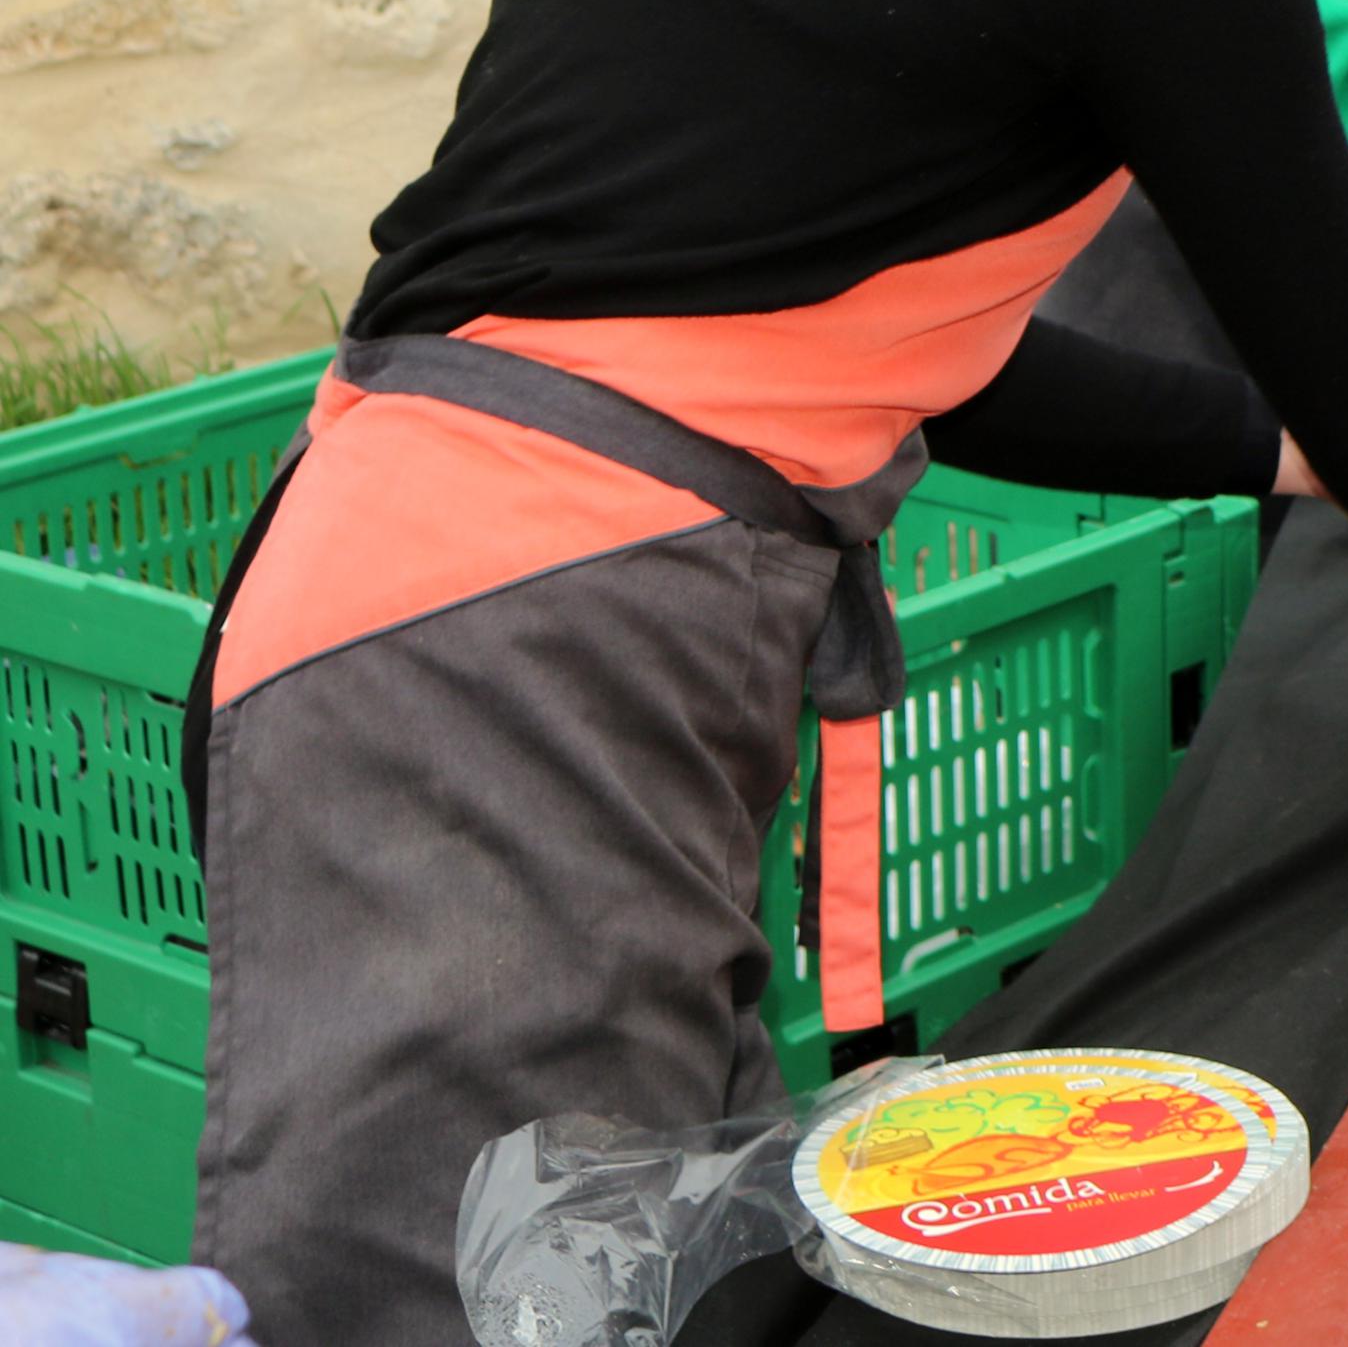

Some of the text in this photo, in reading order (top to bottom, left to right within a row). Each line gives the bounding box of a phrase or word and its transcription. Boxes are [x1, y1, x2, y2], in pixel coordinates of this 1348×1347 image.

[902, 1177, 1106, 1237] Comida
[1066, 1188, 1156, 1212] para llevar
